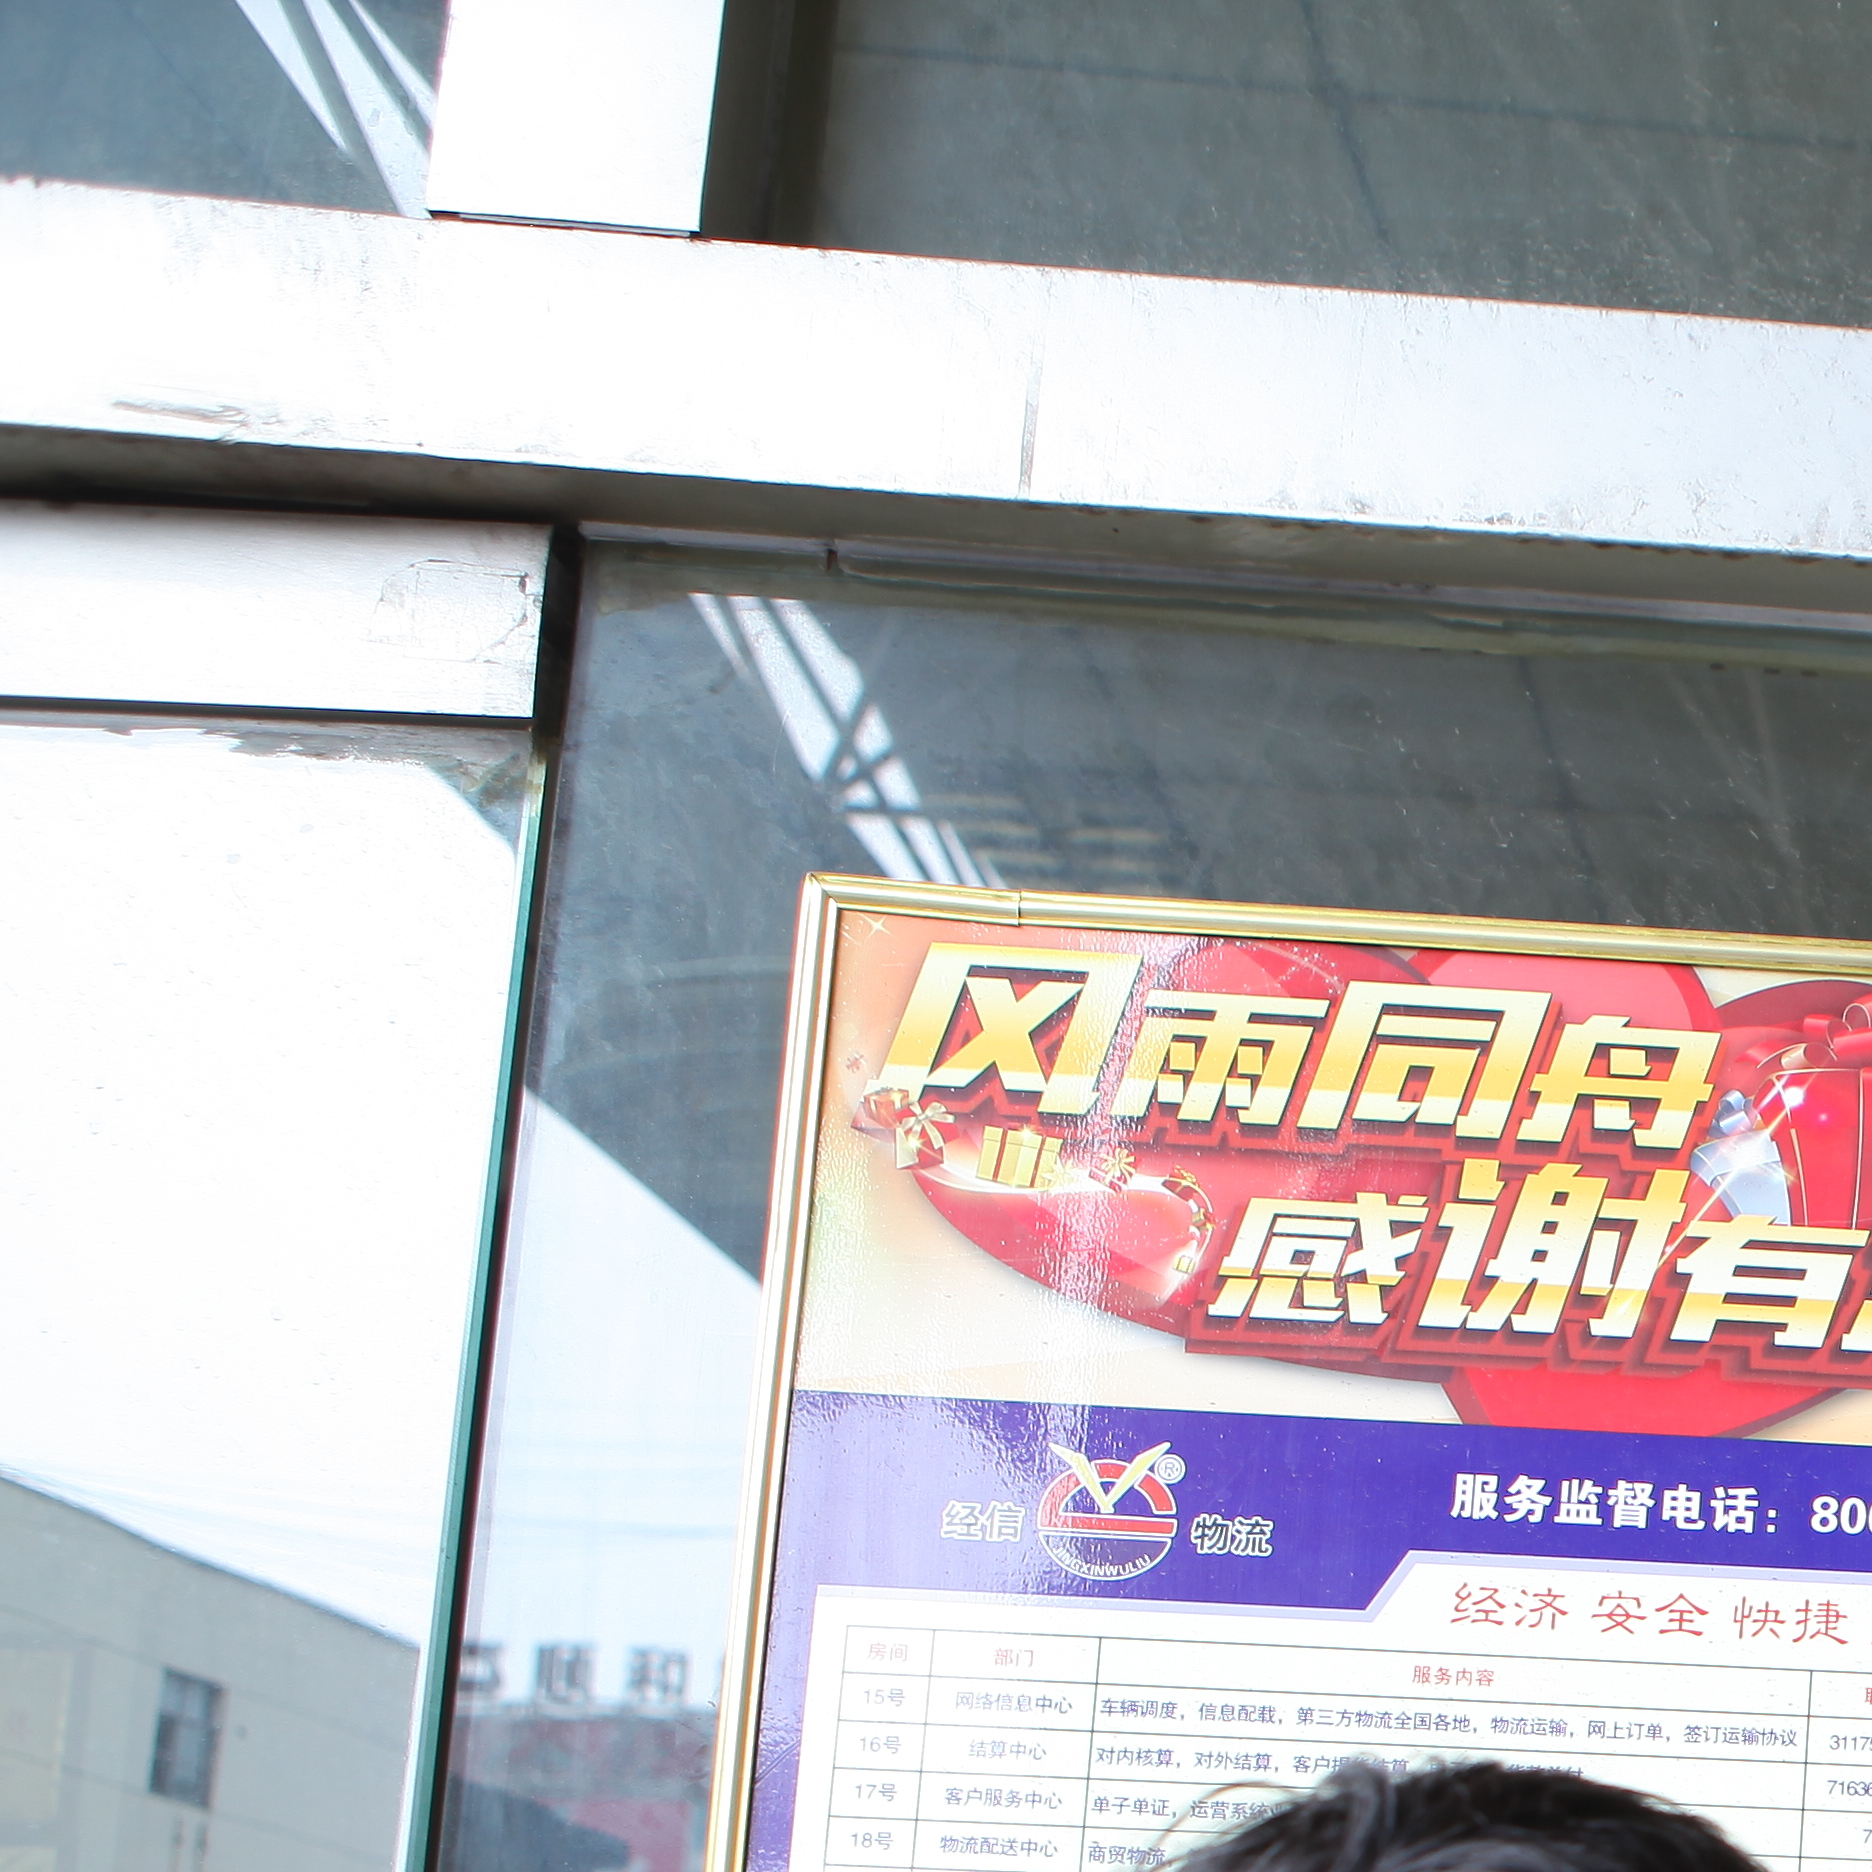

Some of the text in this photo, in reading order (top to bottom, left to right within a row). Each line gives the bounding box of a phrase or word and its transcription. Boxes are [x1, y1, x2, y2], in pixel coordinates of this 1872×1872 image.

[876, 940, 1724, 1152] 风雨同舟
[940, 1499, 1276, 1558] 经信 物流
[1052, 1546, 1152, 1577] JINGXINWULIU
[1449, 1582, 1570, 1632] 经济
[1590, 1589, 1711, 1640] 安全
[1731, 1595, 1849, 1648] 快捷
[866, 1641, 909, 1662] 房间
[993, 1647, 1036, 1669] 部门
[1411, 1664, 1495, 1688] 服务内容
[862, 1687, 906, 1708] 15号
[954, 1690, 1073, 1715] 网络信息中心
[858, 1735, 903, 1756] 16号
[967, 1738, 1048, 1762] 结算中心
[854, 1782, 898, 1804] 17号
[943, 1785, 1063, 1812] 客户服务中心
[849, 1830, 894, 1851] 18号
[939, 1834, 1059, 1859] 物流配送中心
